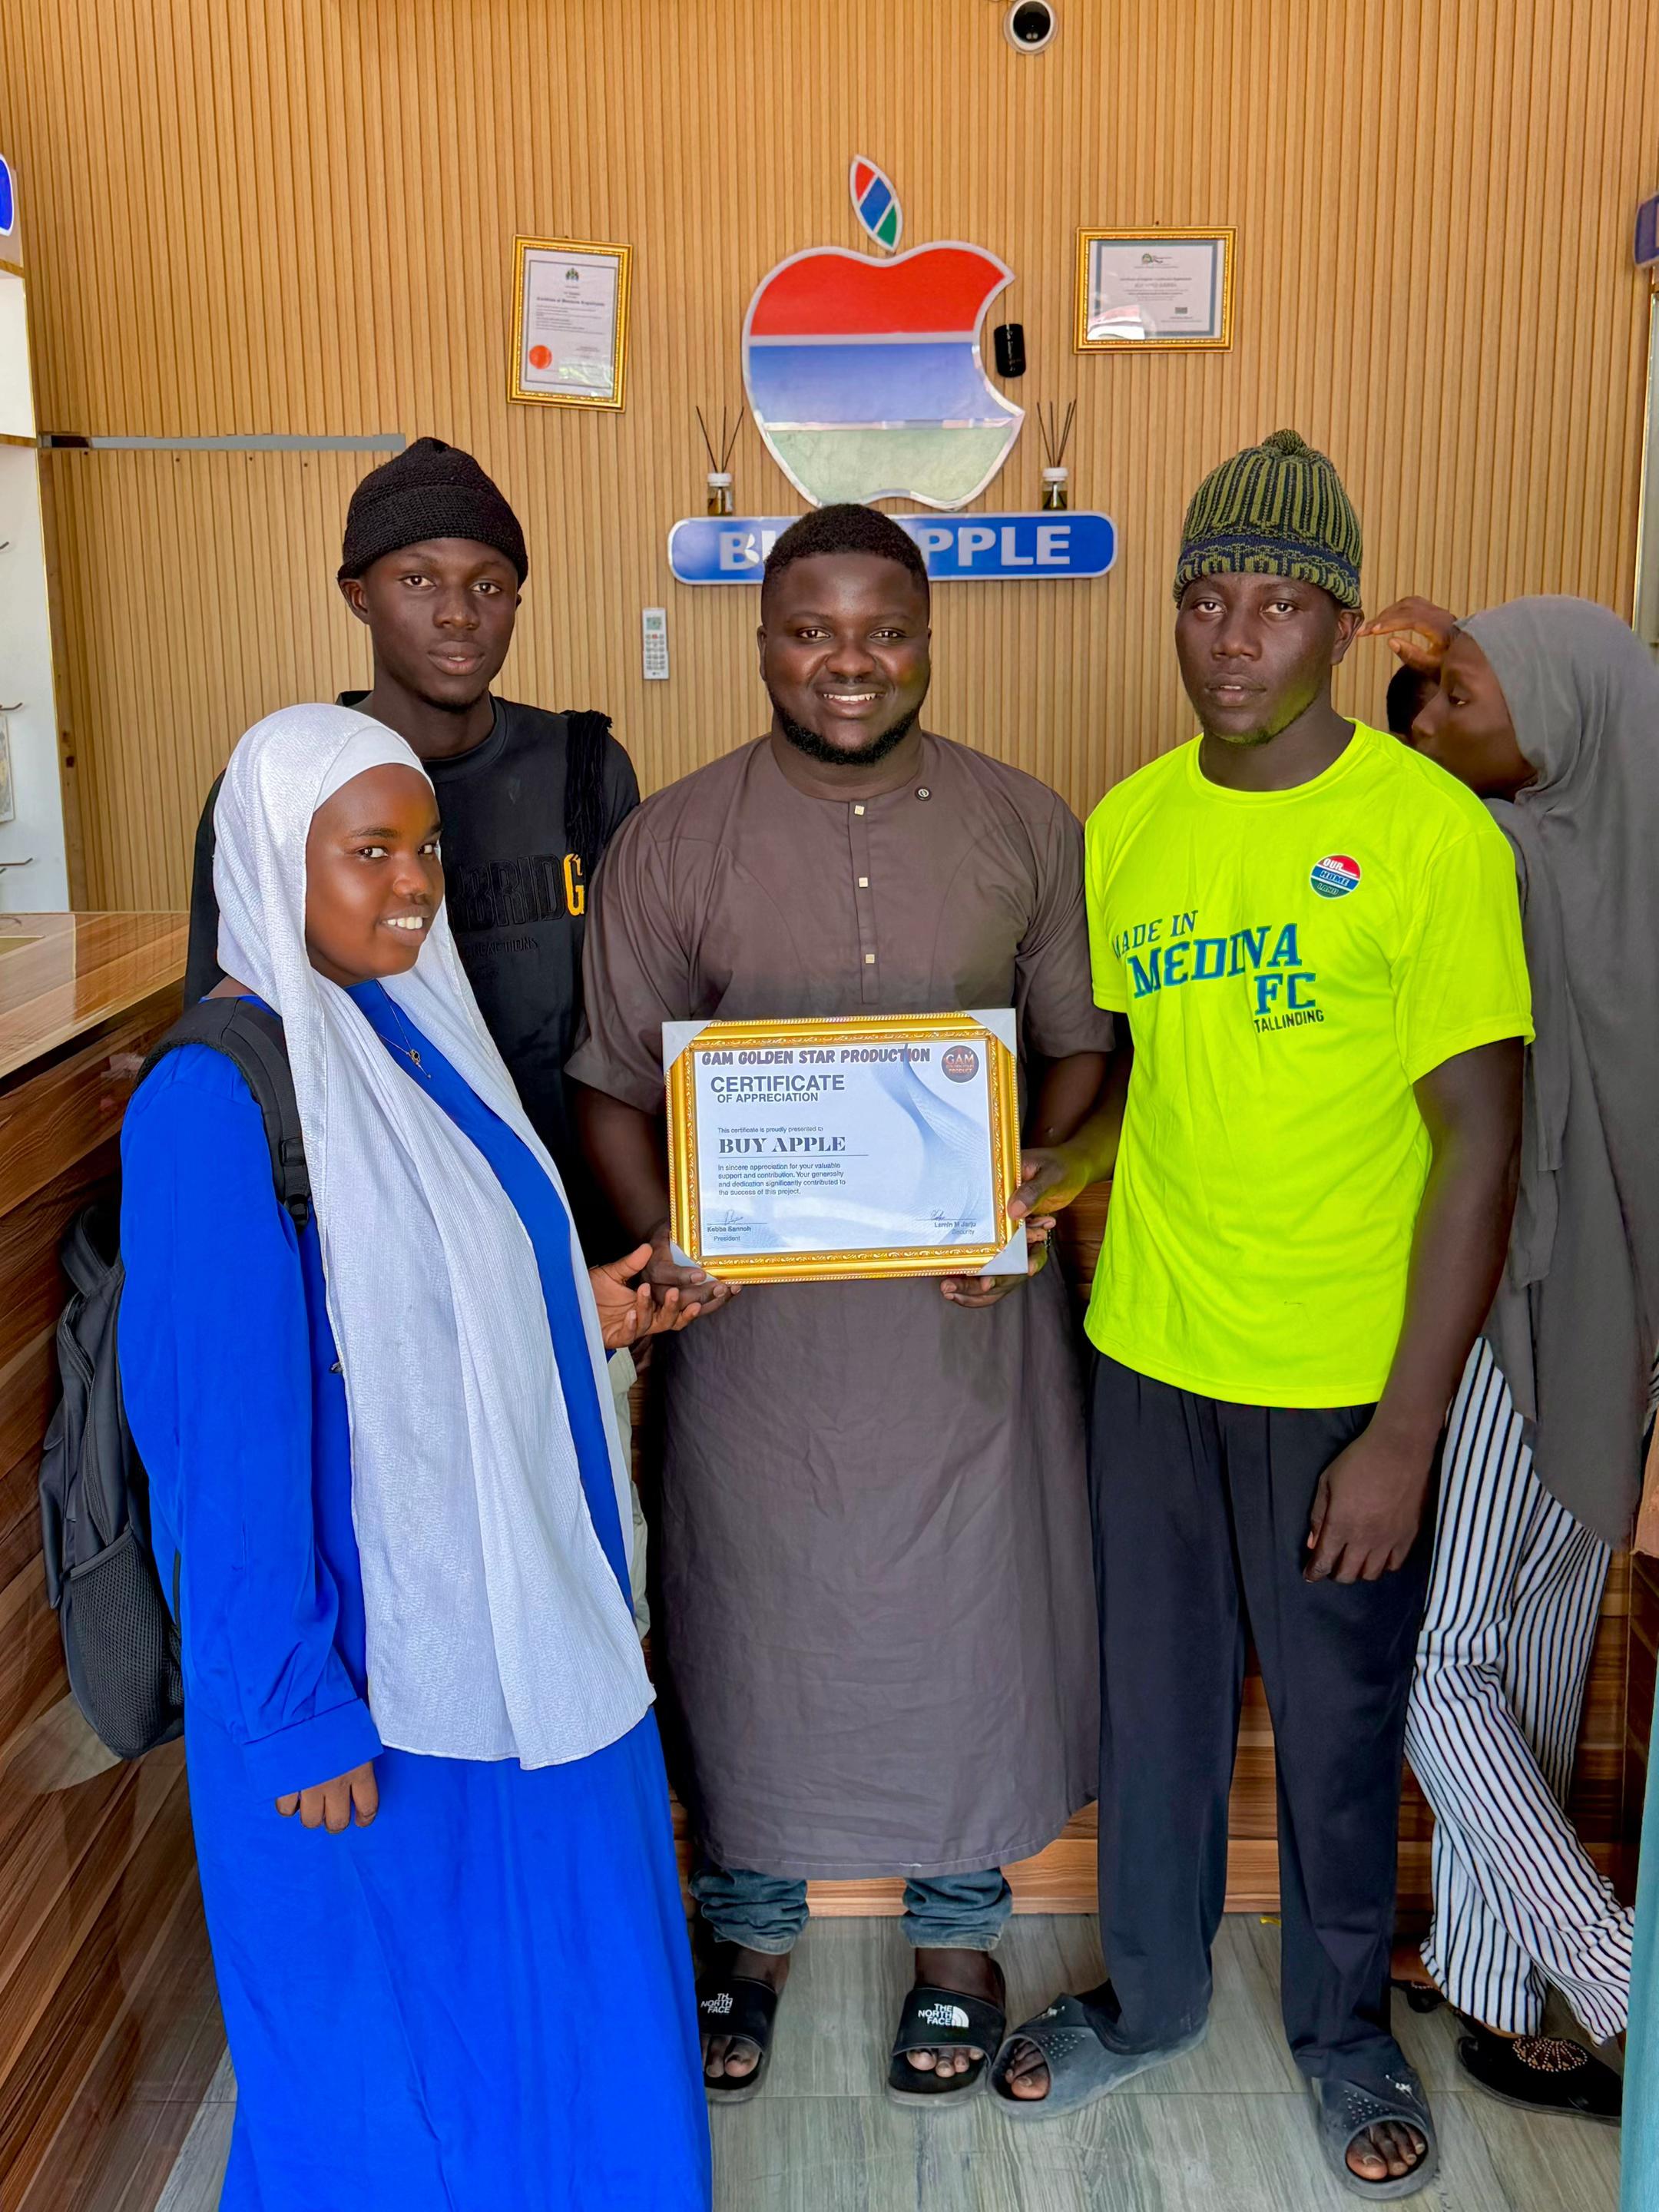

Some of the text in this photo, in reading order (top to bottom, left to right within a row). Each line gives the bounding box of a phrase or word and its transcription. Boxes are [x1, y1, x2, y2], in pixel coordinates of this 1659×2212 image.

[918, 525, 1071, 567] PPLE
[1323, 858, 1344, 870] OUR
[1320, 869, 1351, 886] HOME
[1170, 909, 1199, 938] IN
[1127, 922, 1303, 998] MEDINA
[1253, 972, 1316, 1016] FC
[1253, 1009, 1325, 1034] TALLINDING
[702, 1048, 930, 1065] GAM GOLDEN STAR PRODUCTION
[945, 1054, 974, 1065] GAM
[710, 1075, 845, 1093] CERTIFICATE
[717, 1092, 819, 1104] OF APPRECIATION
[766, 1126, 787, 1134] proudly
[719, 1136, 846, 1154] BUY APPLE
[750, 1164, 788, 1172] appreciation
[811, 1171, 845, 1179] generosity
[765, 1180, 802, 1188] significantly
[700, 1998, 733, 2008] NORTH
[933, 2003, 953, 2012] THE
[707, 2005, 730, 2014] FACE
[918, 2008, 952, 2018] NORTH
[926, 2017, 951, 2026] FACE
